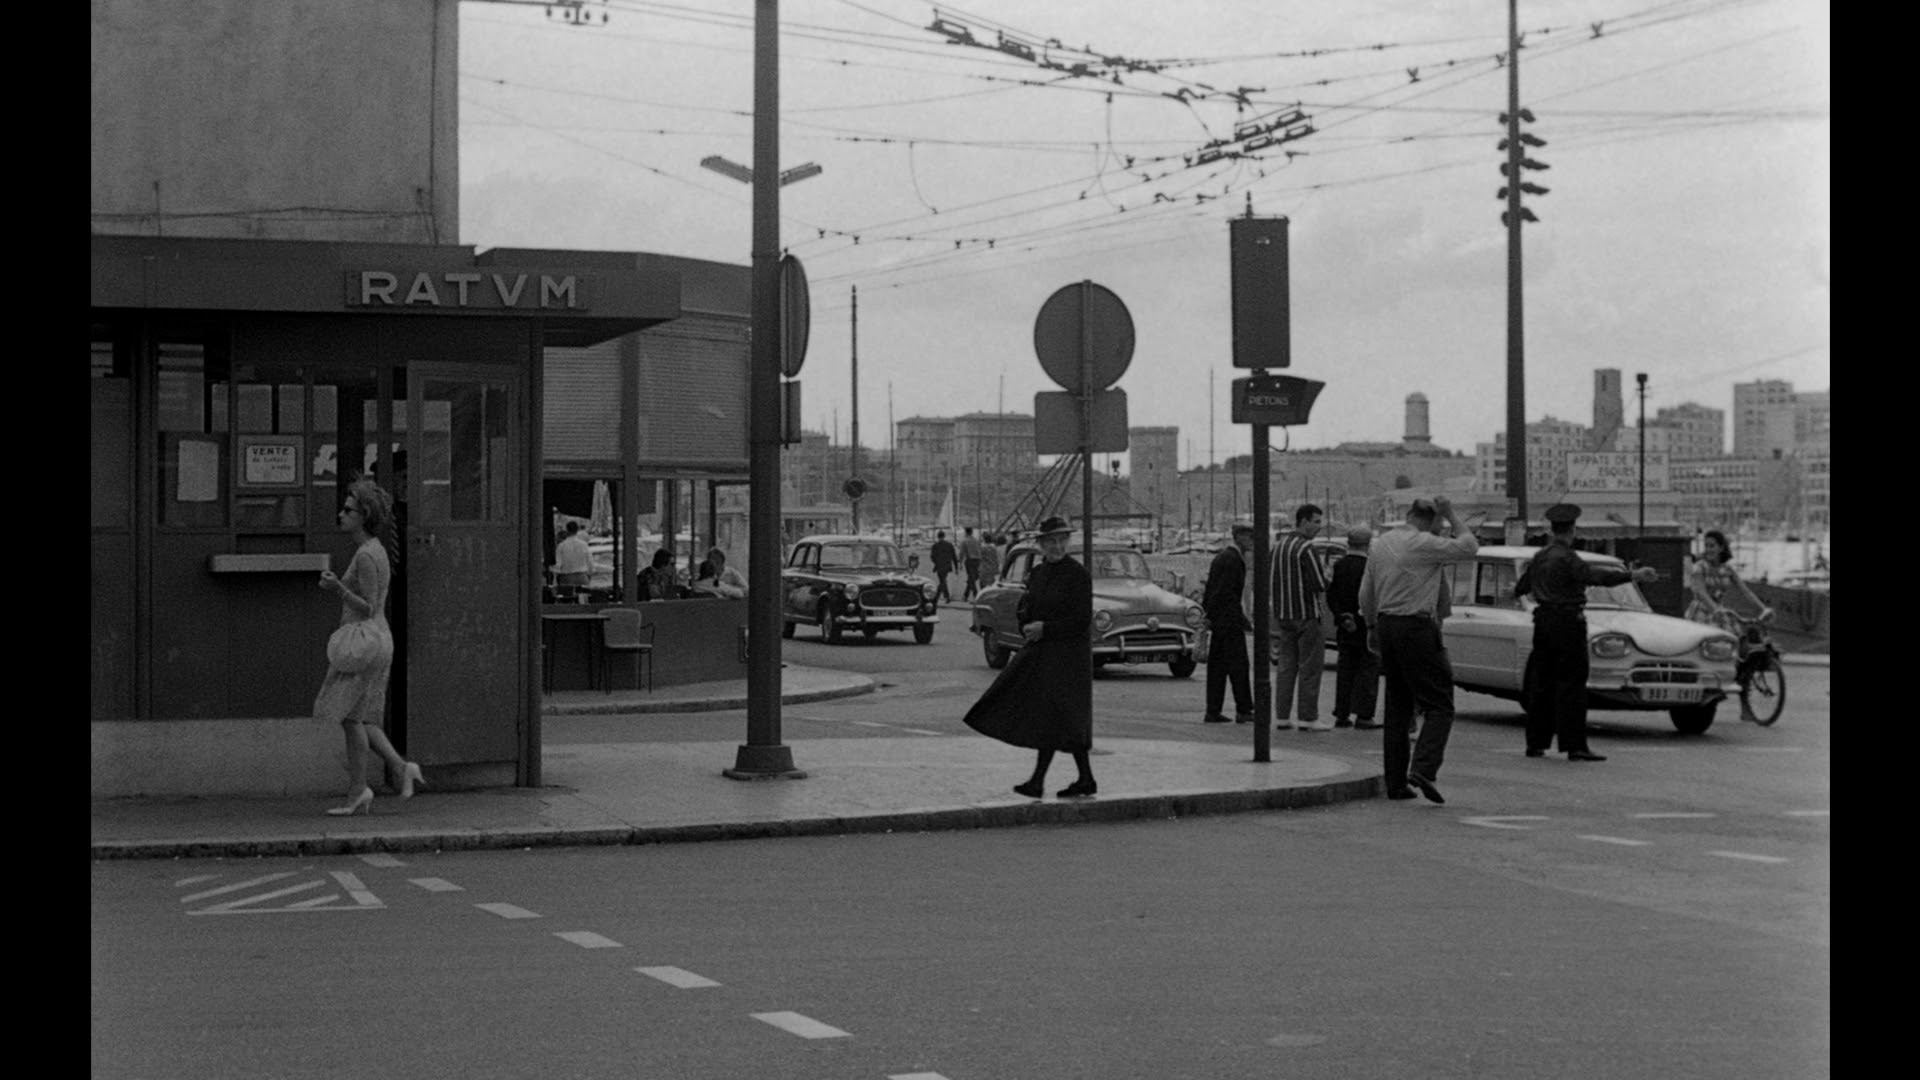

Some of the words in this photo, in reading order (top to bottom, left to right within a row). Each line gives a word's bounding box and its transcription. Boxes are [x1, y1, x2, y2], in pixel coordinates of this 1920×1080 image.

[361, 270, 577, 308] RATVM
[252, 447, 290, 455] VENTE
[1615, 455, 1627, 465] DE
[1634, 455, 1663, 465] PCHE
